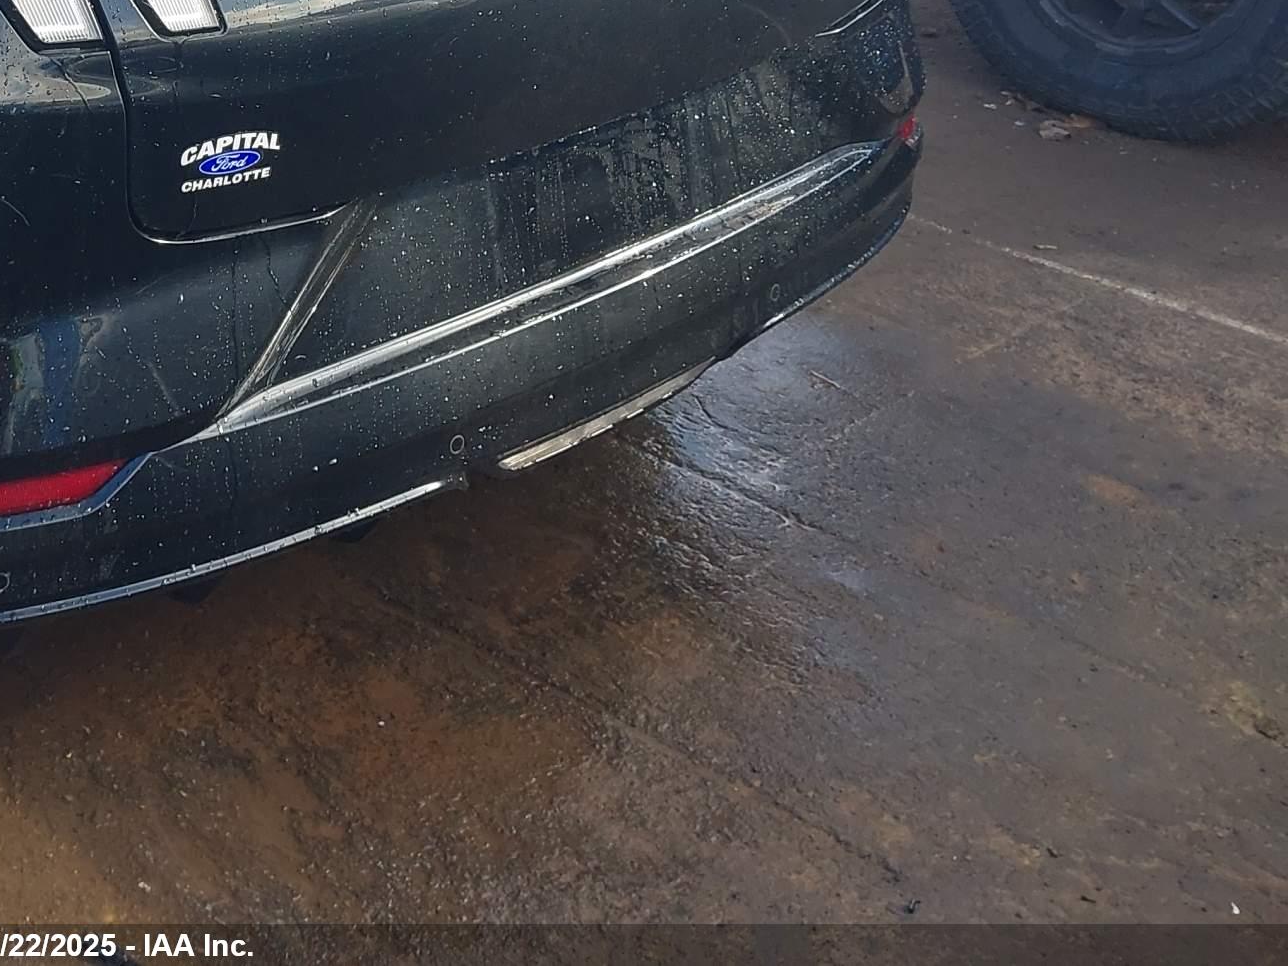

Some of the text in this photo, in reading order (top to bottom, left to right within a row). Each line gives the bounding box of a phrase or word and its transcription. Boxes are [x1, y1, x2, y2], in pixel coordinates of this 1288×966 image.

[180, 132, 281, 166] CAPITAL
[211, 153, 249, 172] Ford
[181, 167, 271, 193] CHARLOTTE
